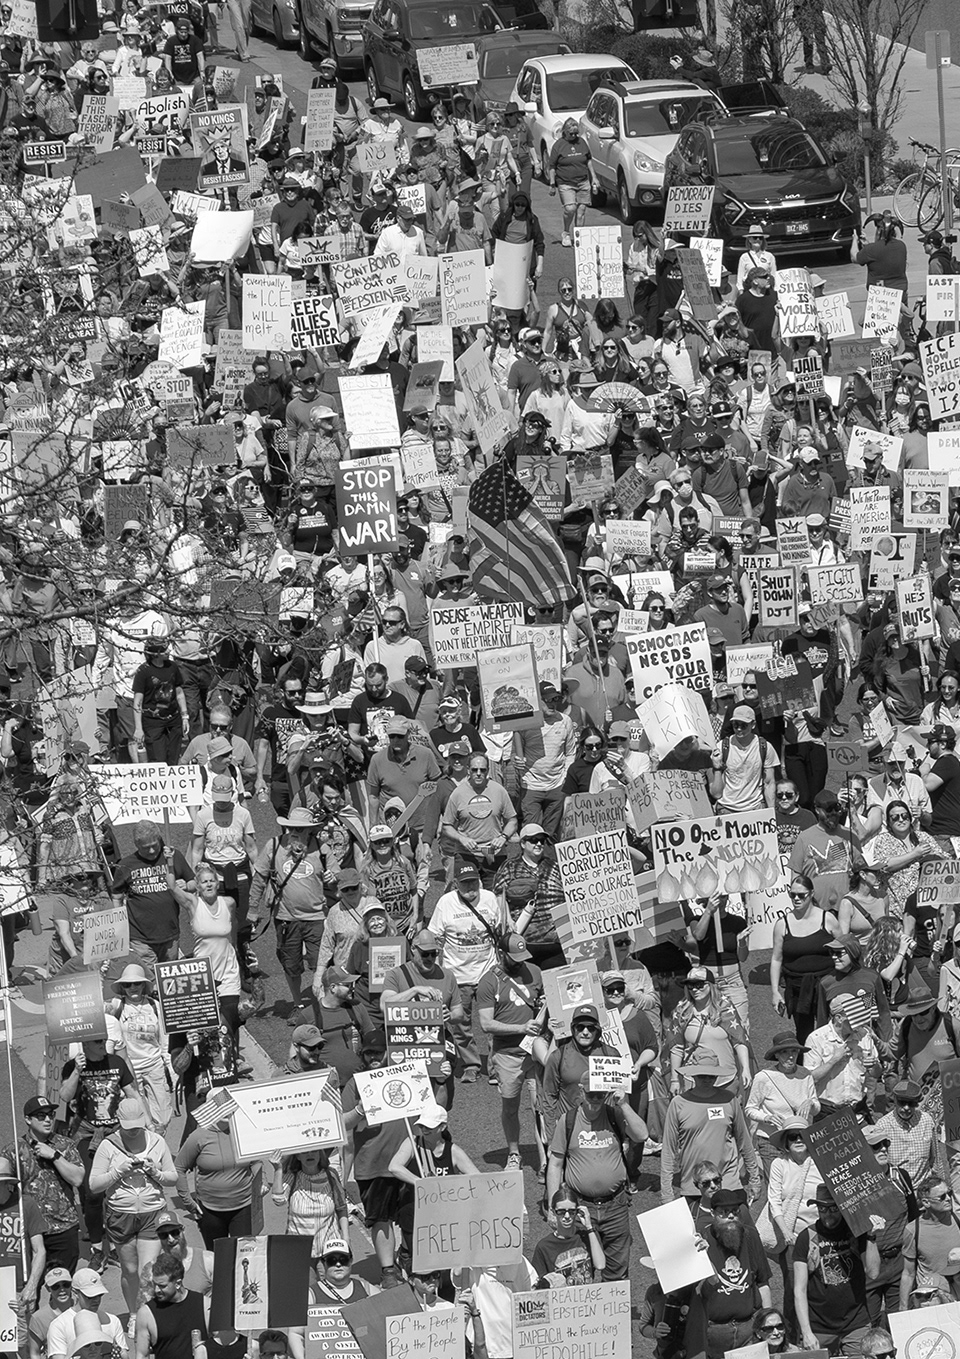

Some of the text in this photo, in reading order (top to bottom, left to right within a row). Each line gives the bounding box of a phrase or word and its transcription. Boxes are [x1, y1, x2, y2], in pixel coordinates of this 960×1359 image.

[138, 99, 186, 115] Abolish
[198, 114, 235, 126] NO KINGS
[27, 144, 62, 155] RESIST
[203, 172, 245, 185] RESIST FASCISM
[670, 186, 712, 200] DEMOCRACY
[675, 204, 702, 214] DIES
[666, 221, 707, 230] SILENT
[302, 254, 340, 264] NO KINGS
[929, 278, 953, 286] LAST
[343, 469, 391, 490] STOP
[351, 492, 378, 501] THIS
[344, 501, 390, 516] DAMN
[341, 514, 397, 546] WAR!
[761, 575, 793, 589] SHUT
[818, 568, 855, 587] FIGHT
[764, 589, 793, 602] DOWN
[812, 587, 862, 604] FASCISM
[905, 593, 925, 604] HE'S
[767, 607, 793, 618] DJT
[902, 608, 931, 627] NUTS
[628, 628, 706, 654] DEMOCRACY
[639, 647, 691, 668] NEEDS
[666, 660, 707, 679] YOUR
[130, 765, 196, 778] IMPEACH
[130, 778, 196, 791] CONVICT
[131, 793, 188, 805] REMOVE
[655, 818, 777, 849] NO One Mourns
[659, 840, 764, 868] The WICKED
[85, 910, 127, 929] CONSTITUTION
[95, 928, 115, 941] UNDER
[91, 938, 124, 956] ATTACK!
[388, 1007, 440, 1021] ICE OUT!
[405, 1048, 430, 1058] LGBT
